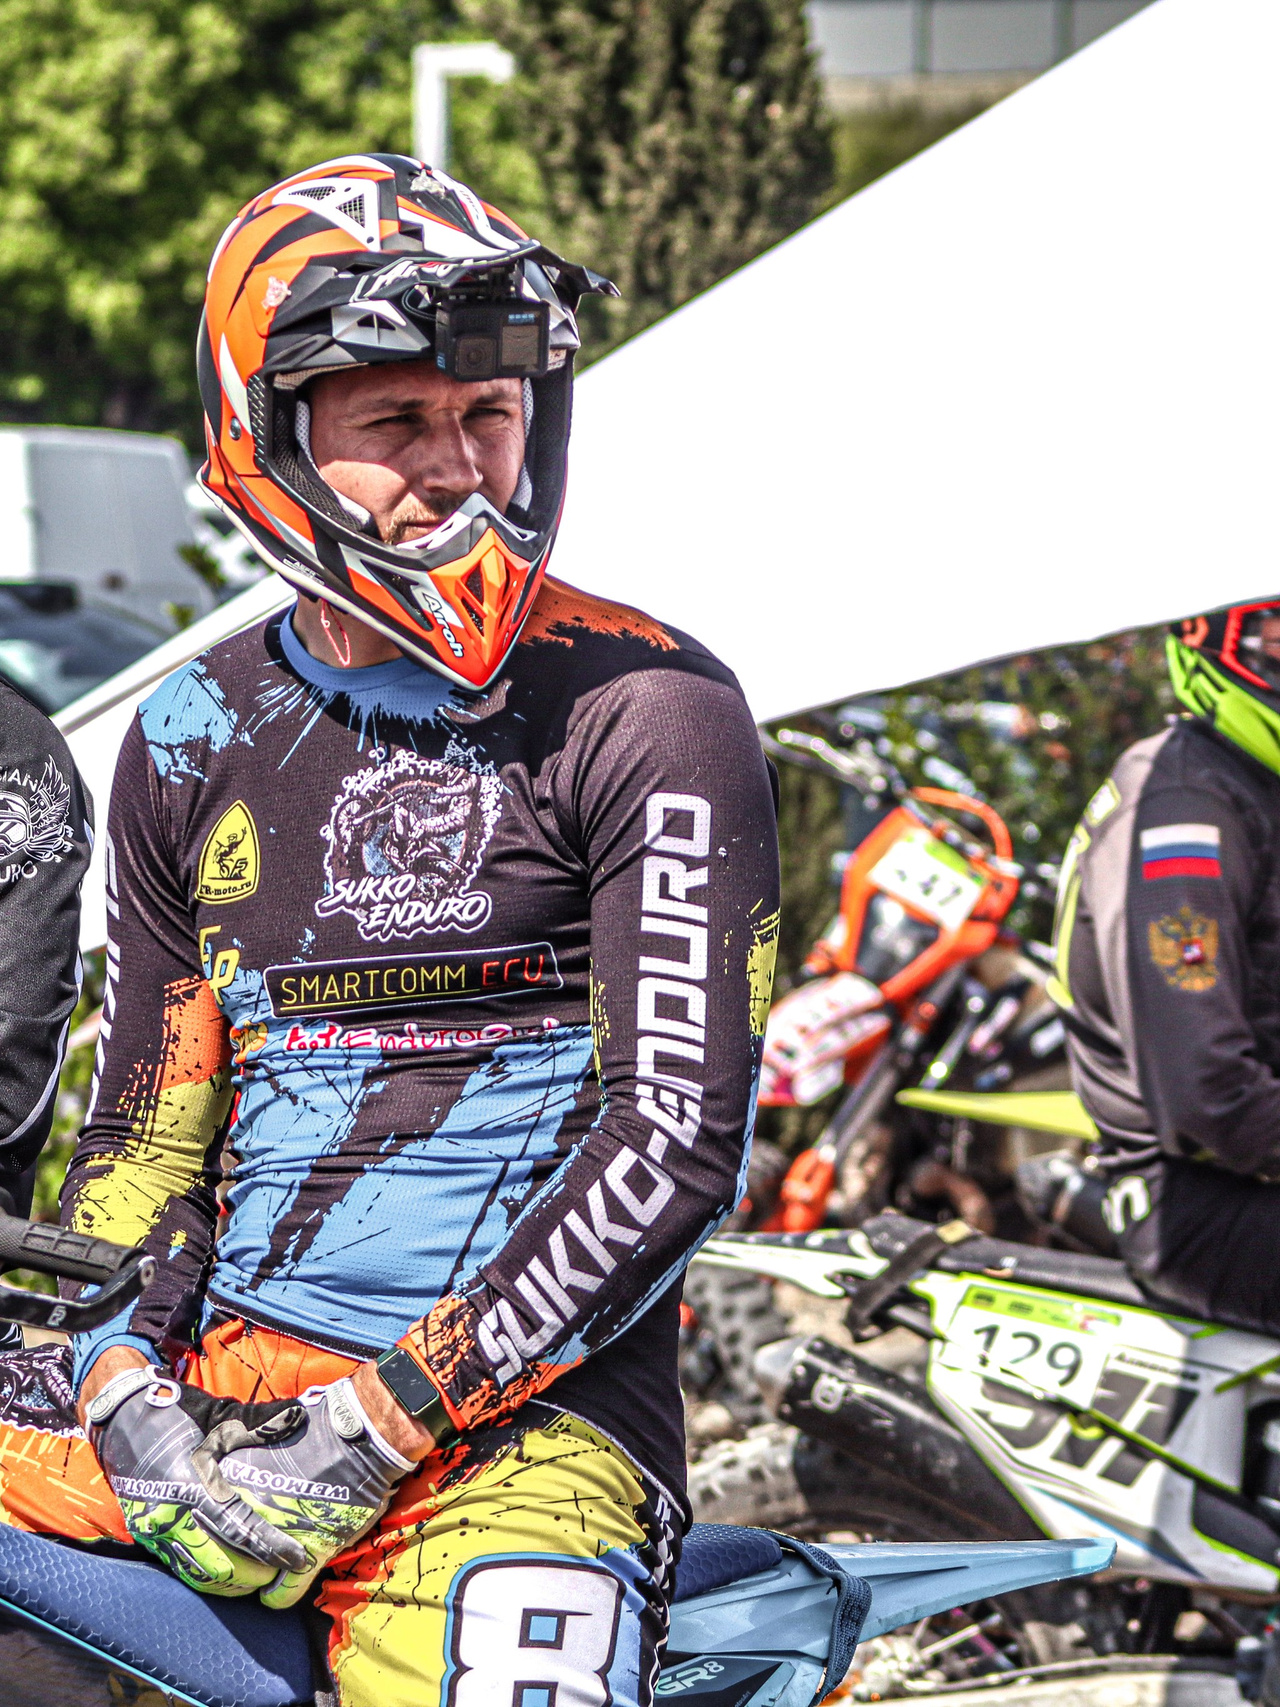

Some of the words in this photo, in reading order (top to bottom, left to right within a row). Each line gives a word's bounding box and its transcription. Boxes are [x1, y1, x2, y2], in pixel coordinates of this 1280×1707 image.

[422, 592, 465, 658] Airoh
[321, 873, 417, 907] SUKKO
[365, 896, 487, 933] ENDURO
[281, 964, 466, 1005] SMARTCOMM
[482, 954, 545, 987] ECU
[973, 1323, 1084, 1388] 129
[654, 1660, 725, 1695] GR8
